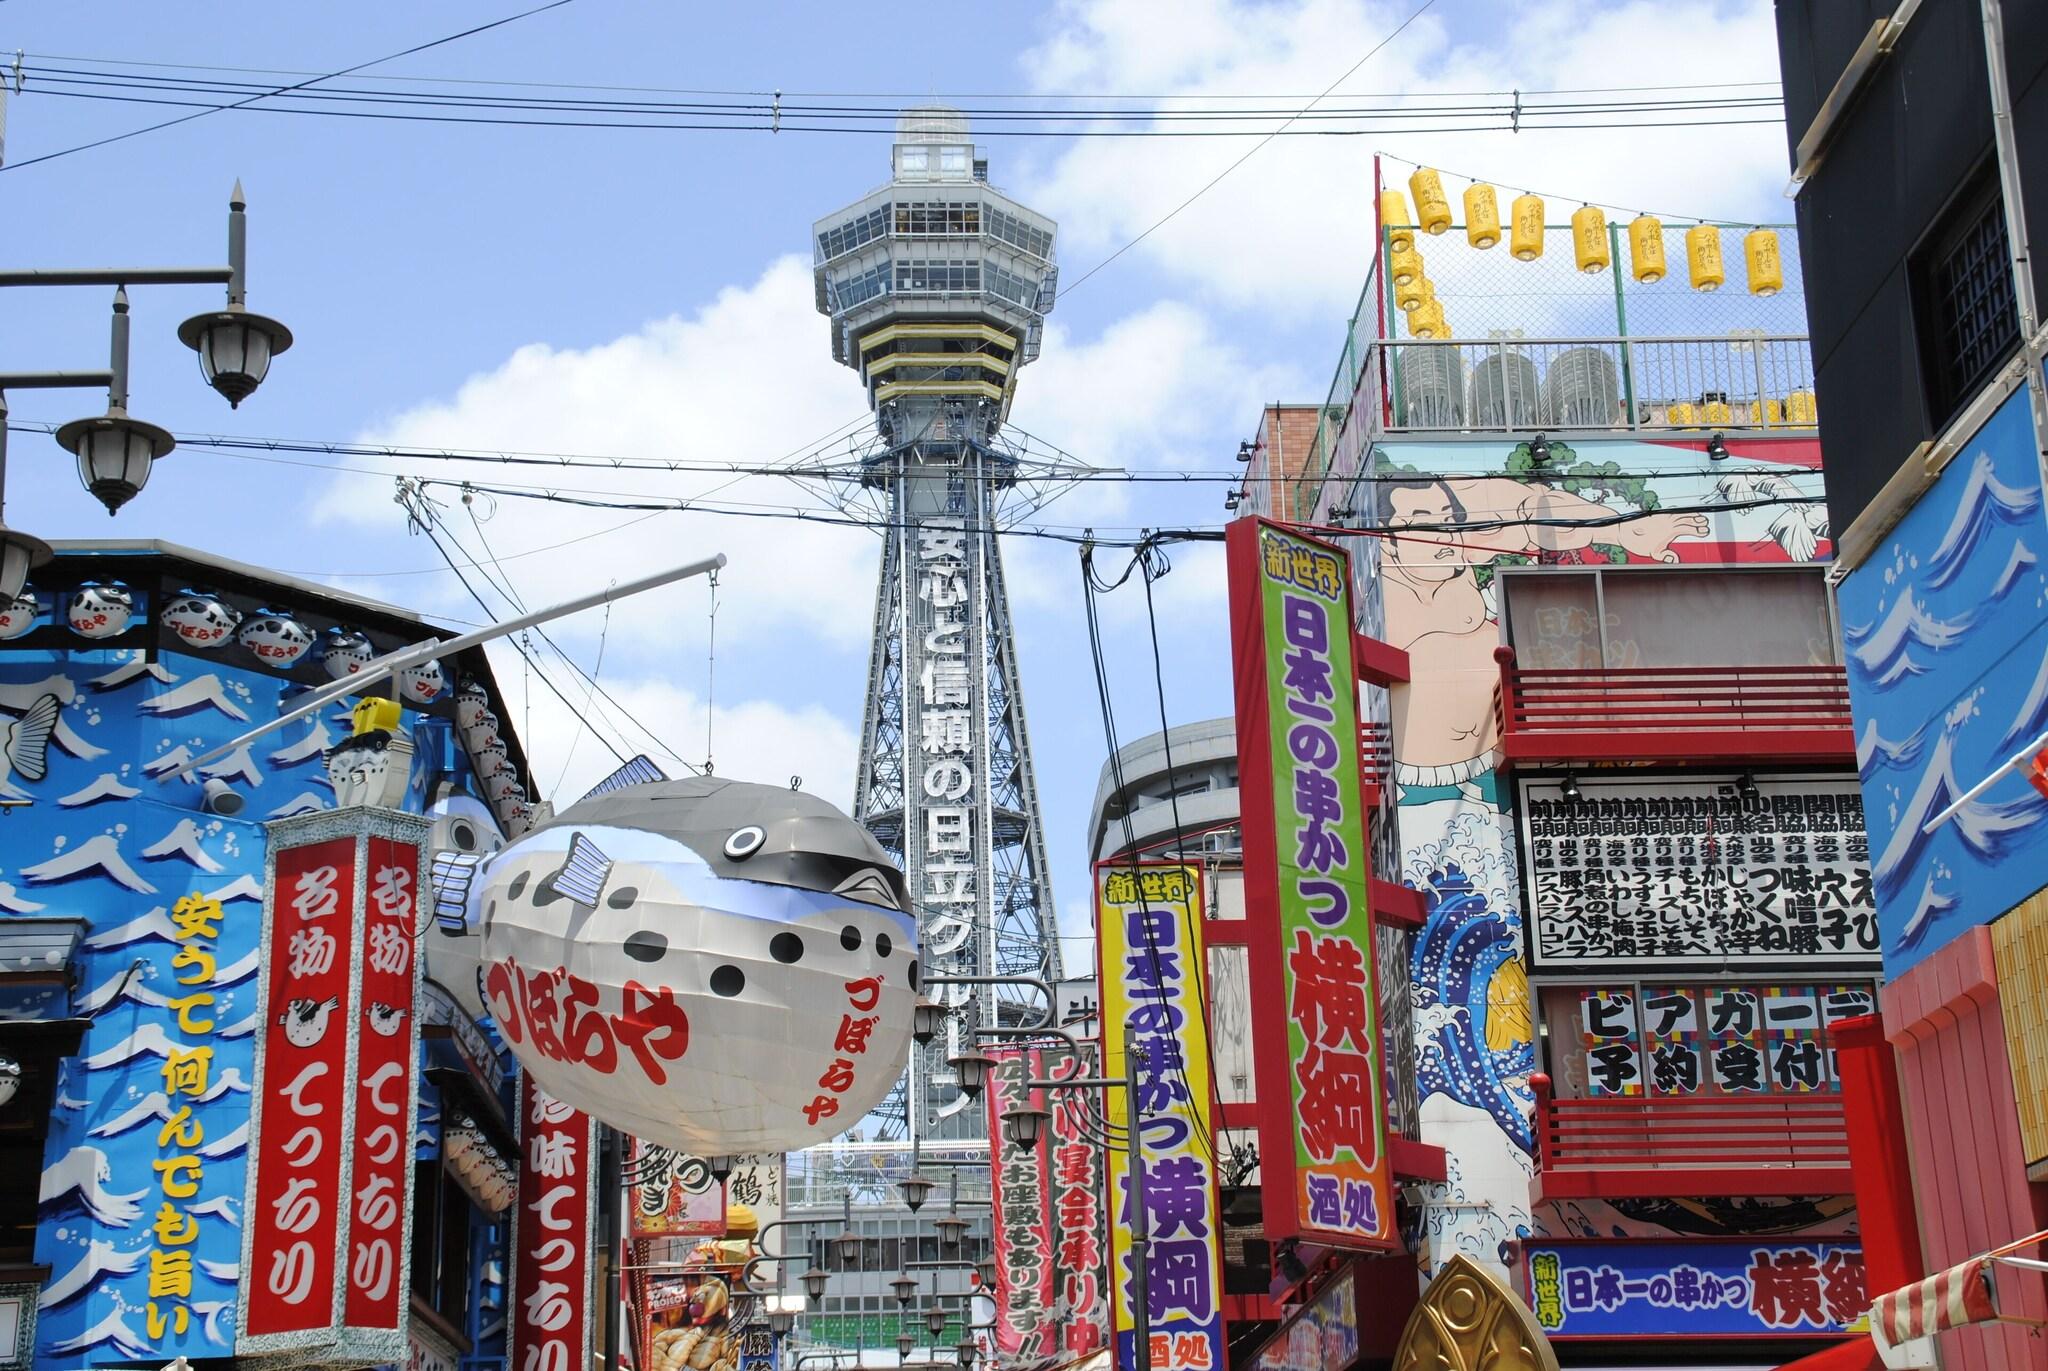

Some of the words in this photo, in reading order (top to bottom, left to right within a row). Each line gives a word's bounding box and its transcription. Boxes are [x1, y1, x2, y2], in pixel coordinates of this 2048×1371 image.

[1264, 535, 1342, 600] 新世界
[1284, 595, 1351, 926] 日本一の串かつ
[1530, 799, 1554, 837] 前頭
[1552, 799, 1578, 837] 前頭
[1576, 798, 1601, 837] 前頭
[1600, 798, 1626, 837] 前頭
[1624, 798, 1650, 837] 前頭
[1647, 797, 1673, 836] 前頭
[1671, 797, 1697, 836] 前頭
[1695, 796, 1720, 835] 前頭
[1719, 796, 1745, 834] 前頭
[1742, 796, 1774, 834] 小結
[1771, 795, 1806, 834] 関脇
[1803, 795, 1839, 833] 関脇
[1836, 794, 1867, 832] 関脇
[369, 865, 412, 976] 名物
[1106, 872, 1193, 904] 新世界
[1584, 869, 1613, 956] 角煮の串かつ
[1606, 870, 1637, 955] いわし梅肉
[1632, 868, 1660, 955] うずら玉子
[1655, 868, 1685, 954] チーズしそ巻
[1679, 867, 1711, 954] もちいそべ
[1727, 866, 1756, 954] じゃが芋
[1749, 867, 1789, 951] つくね
[1814, 868, 1852, 950] 穴子
[288, 866, 338, 980] 名物
[487, 956, 689, 1085] づぼらや
[803, 975, 884, 1125] づぼらや
[1290, 930, 1378, 1172] 横綱
[1590, 1043, 1840, 1092] 予約受付
[145, 890, 223, 1340] 安うて何んでも旨い
[1307, 1175, 1378, 1233] 酒処
[1120, 1157, 1211, 1321] 横綱
[1532, 1252, 1564, 1328] 新世界
[1566, 1267, 1747, 1310] 日本一の串かつ
